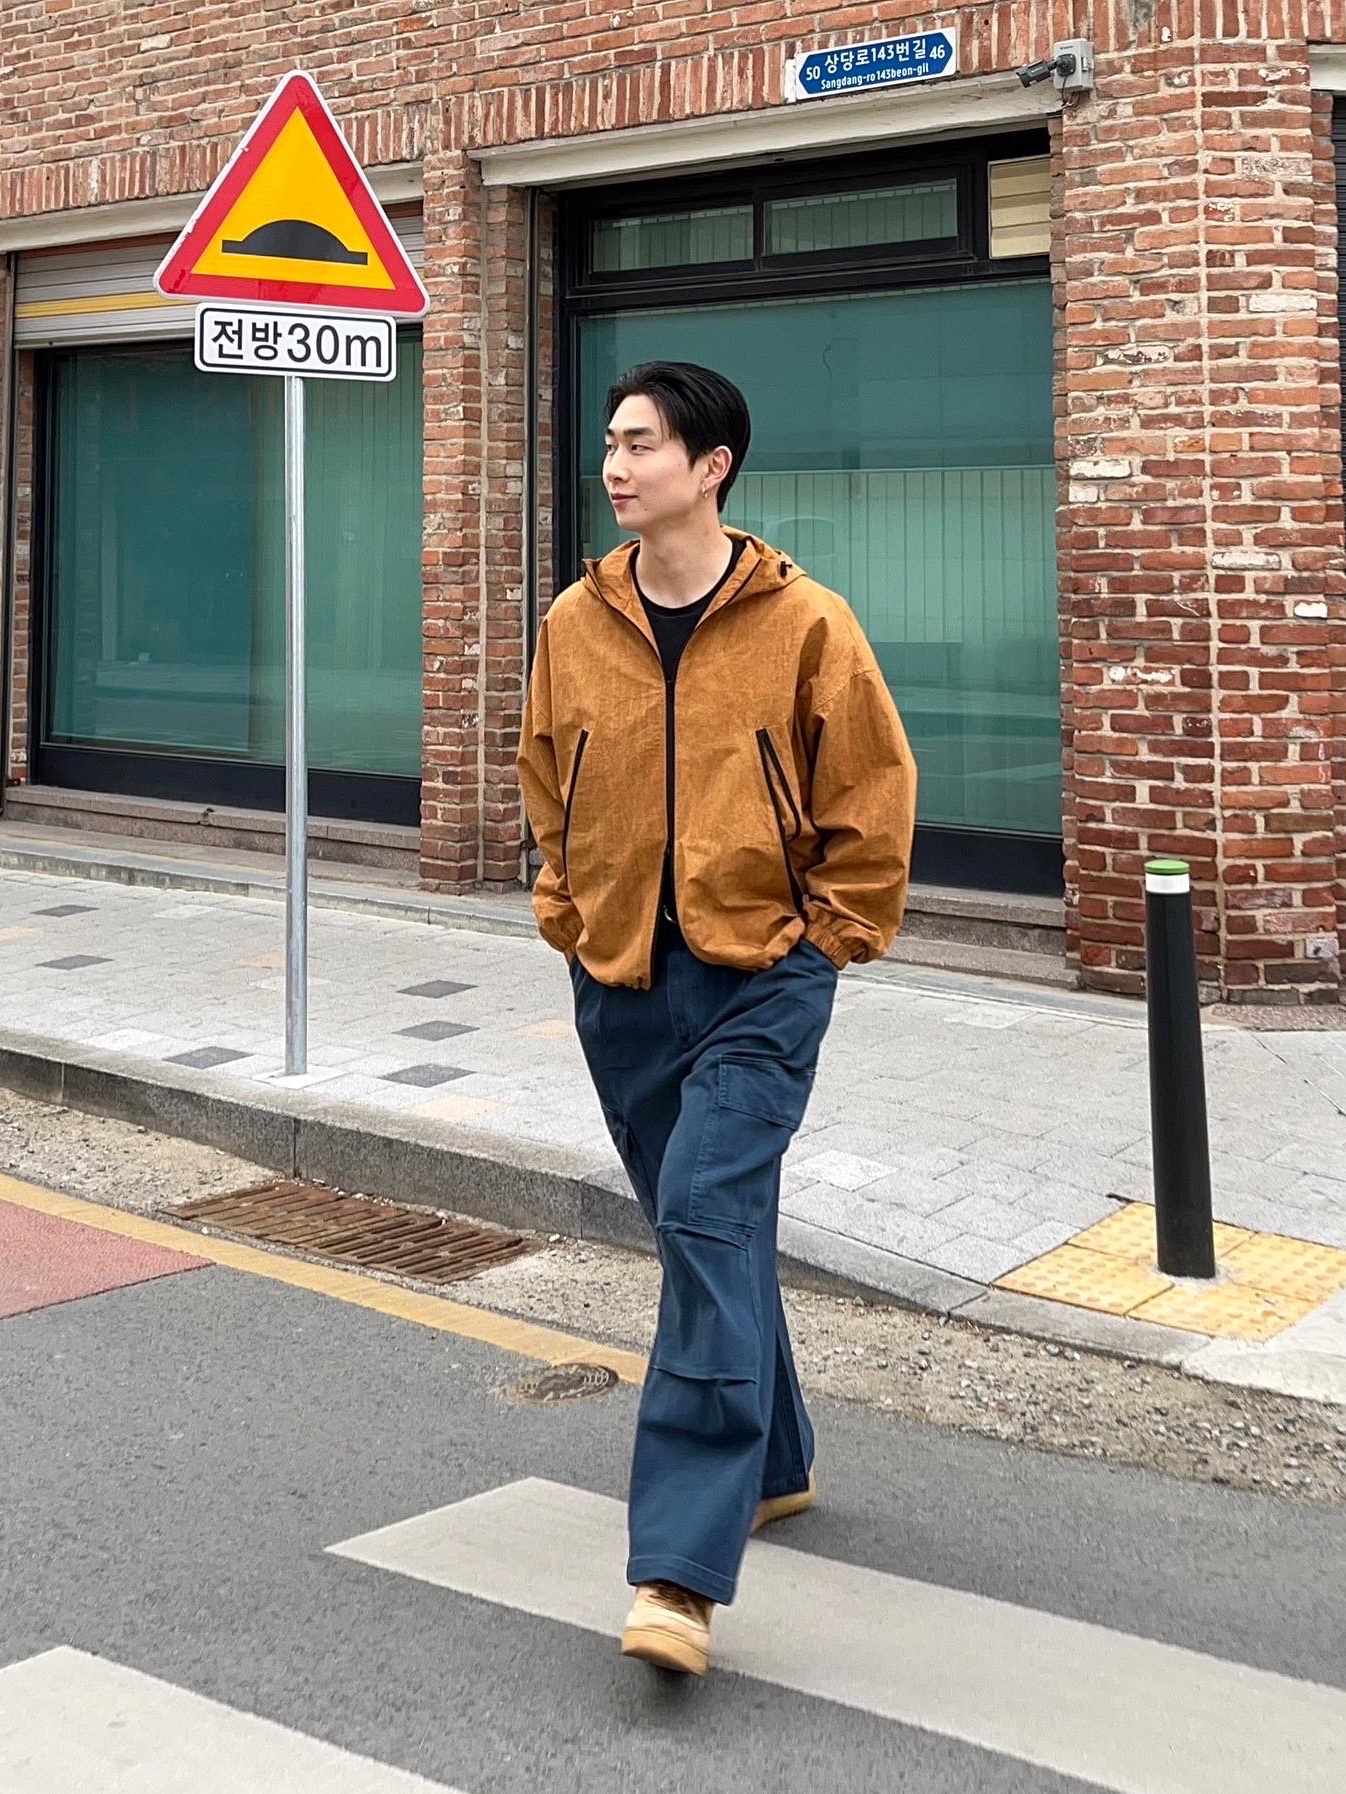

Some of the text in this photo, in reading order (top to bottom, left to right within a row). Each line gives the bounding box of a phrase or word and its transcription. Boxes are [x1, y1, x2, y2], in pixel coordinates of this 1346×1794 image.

[806, 38, 946, 80] 50 상당로143번길 46
